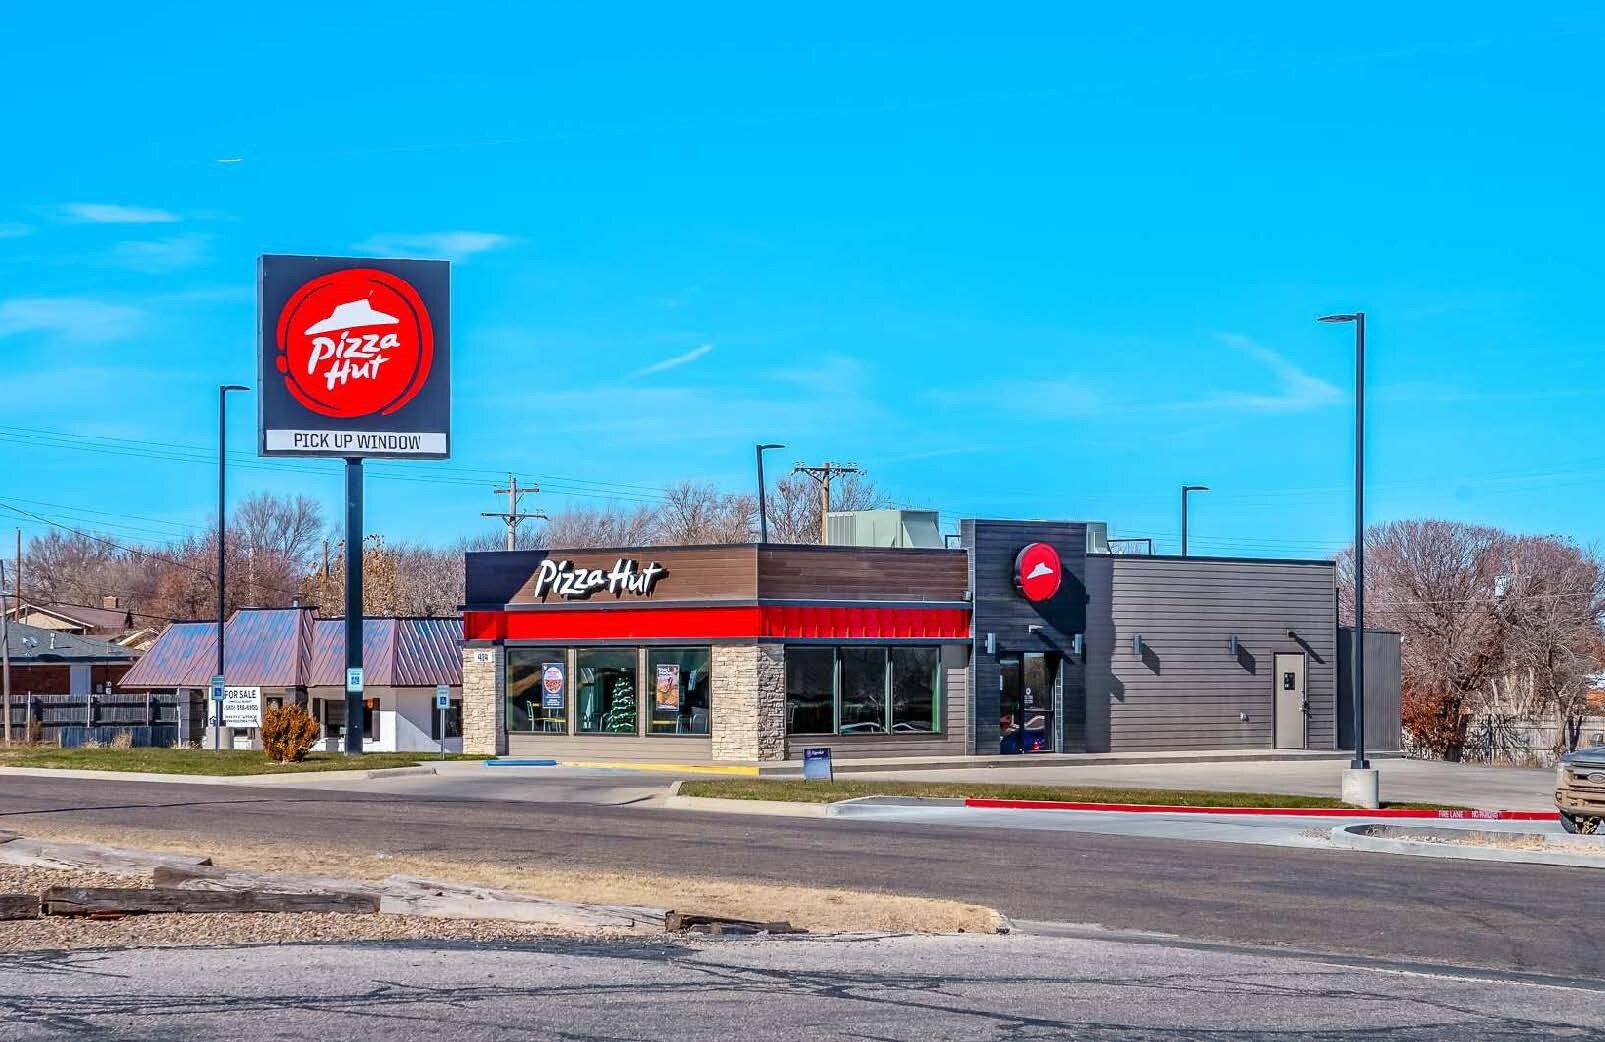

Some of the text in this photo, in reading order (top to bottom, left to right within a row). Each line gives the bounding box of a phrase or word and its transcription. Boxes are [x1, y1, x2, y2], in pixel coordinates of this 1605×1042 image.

[307, 331, 400, 375] Pizza
[324, 354, 391, 391] Hut
[294, 433, 421, 450] PICK UP WINDOW
[534, 558, 663, 598] Pizza Hut
[225, 690, 256, 699] FOR SALE
[1449, 810, 1464, 818] LANE
